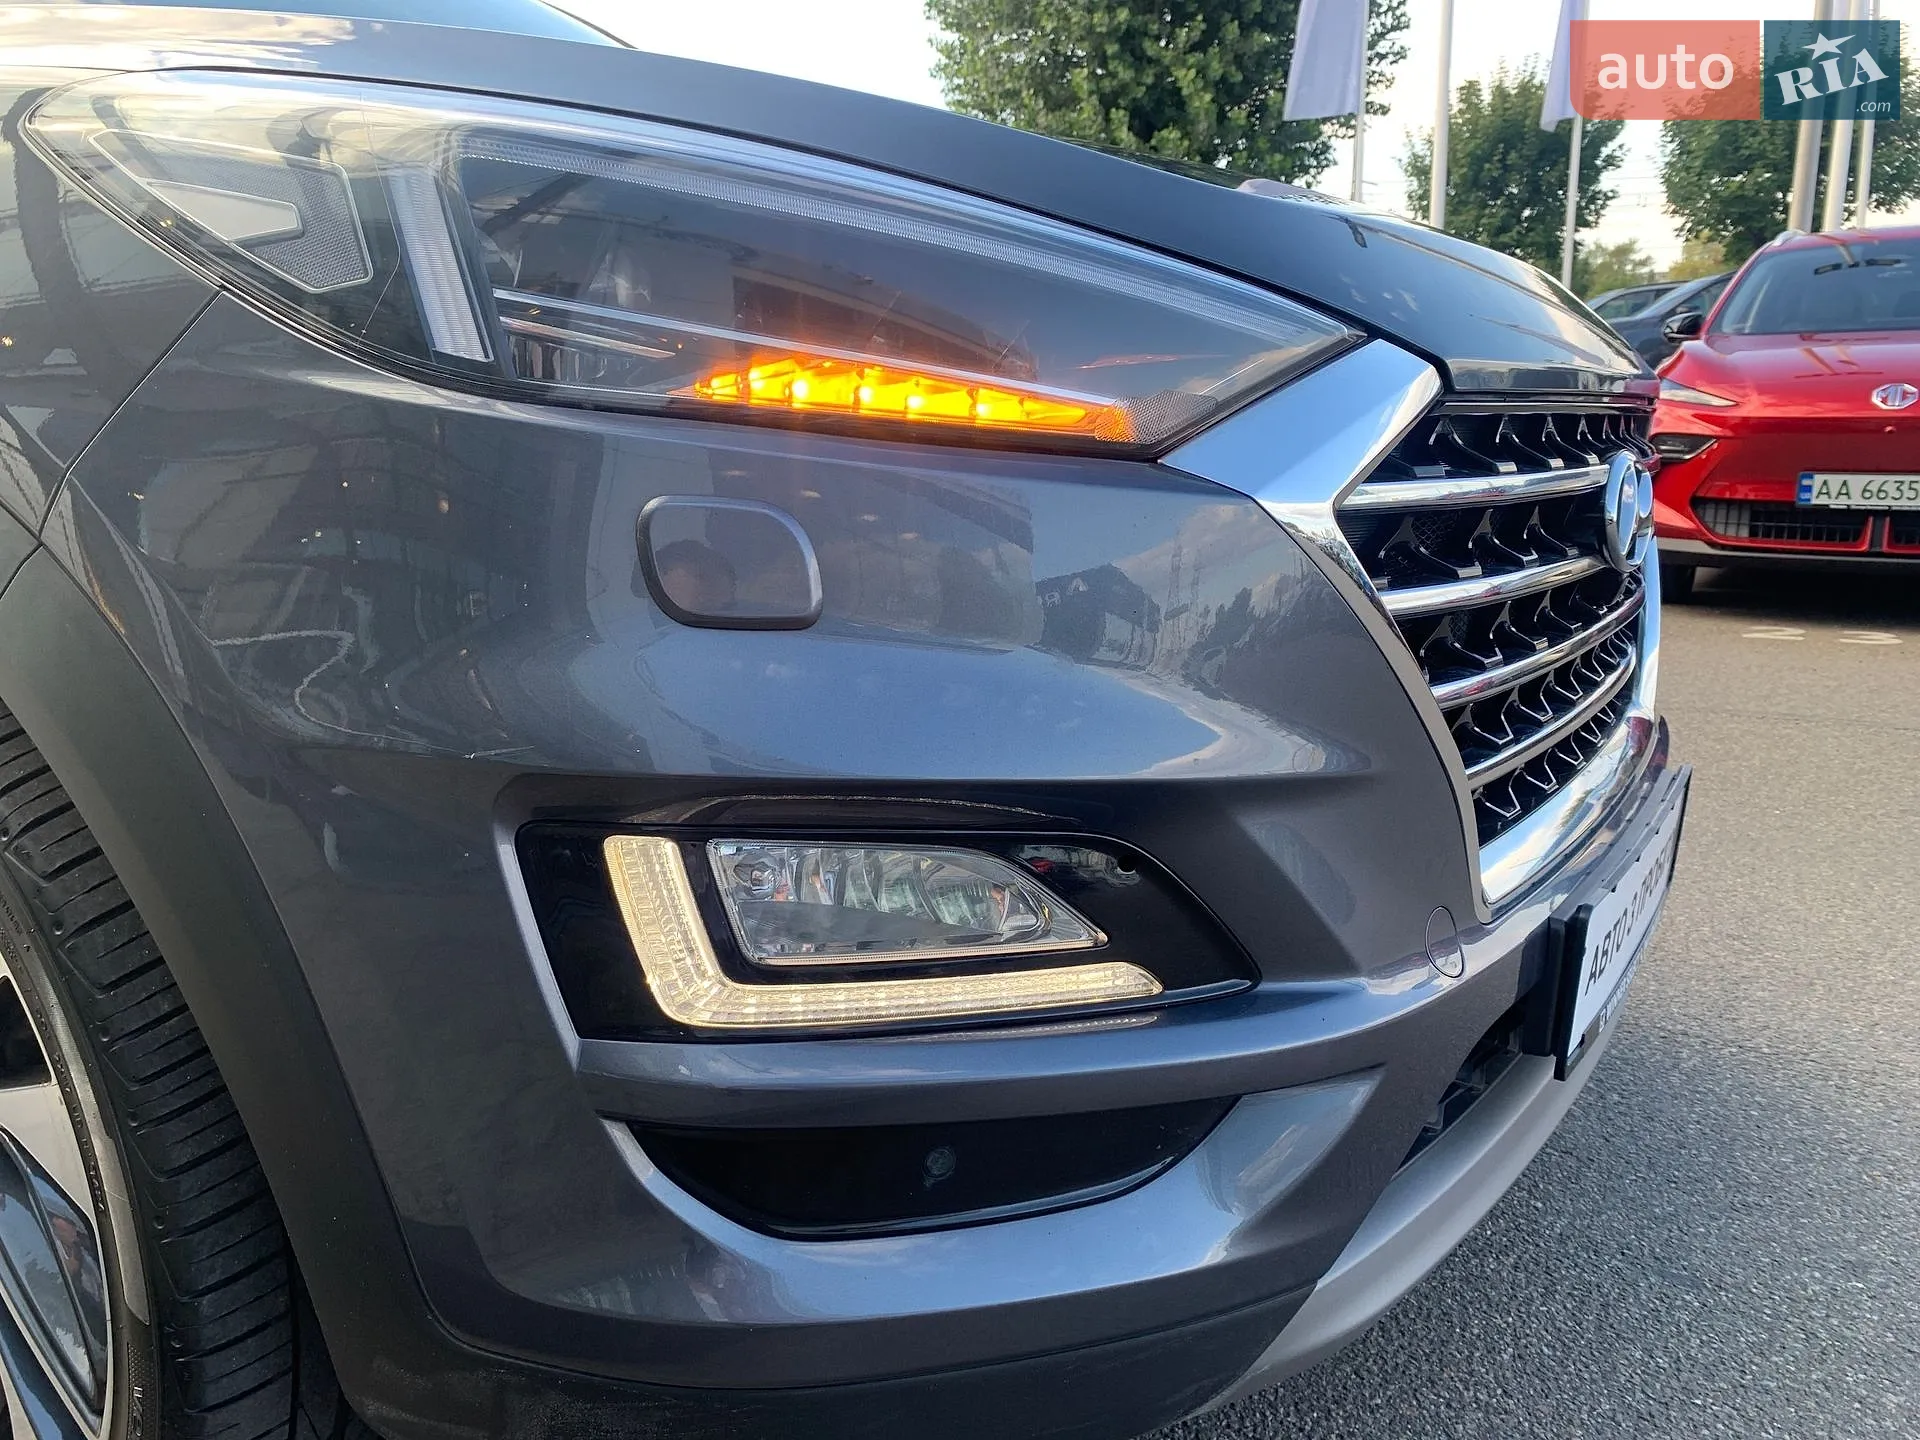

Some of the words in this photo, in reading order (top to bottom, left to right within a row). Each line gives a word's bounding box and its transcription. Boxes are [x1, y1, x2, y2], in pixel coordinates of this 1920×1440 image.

[1874, 384, 1919, 408] MG
[1816, 479, 1851, 500] AA
[1861, 479, 1919, 501] 6635
[1585, 907, 1628, 996] АВТО
